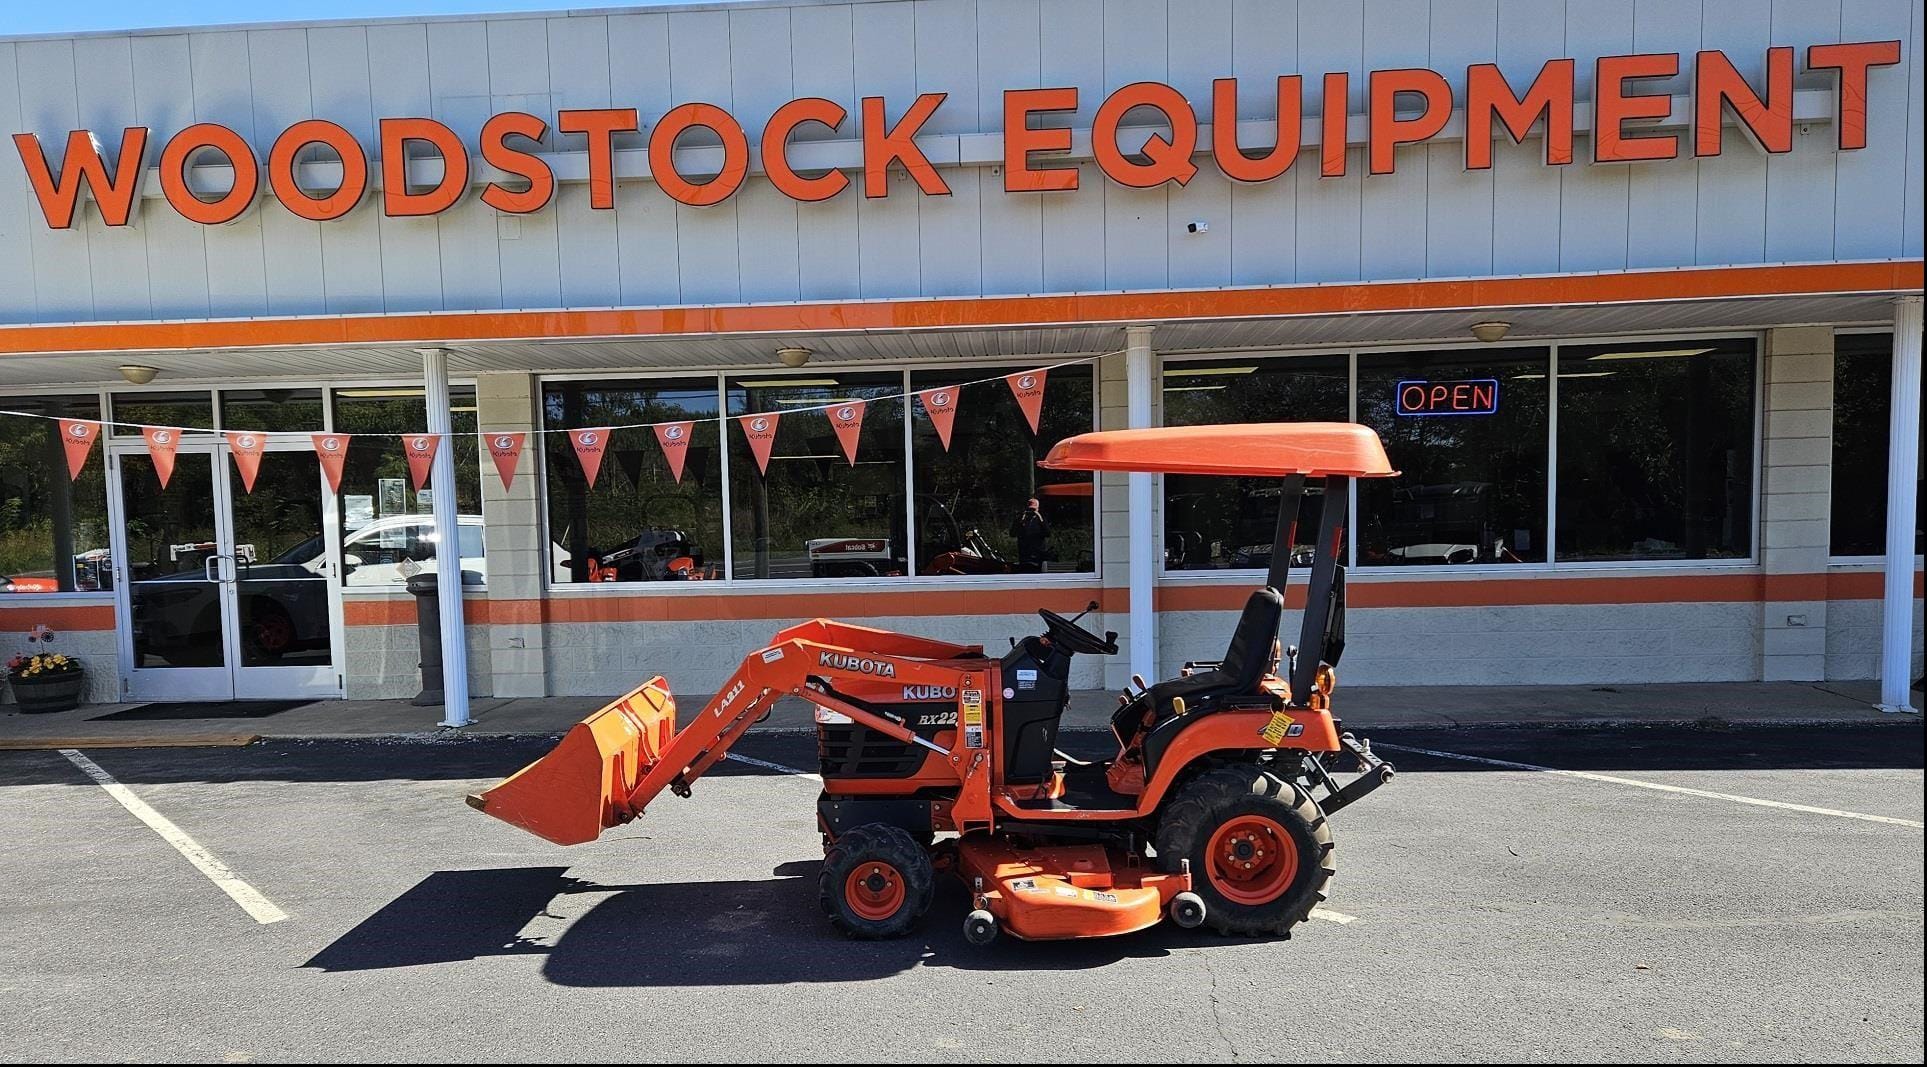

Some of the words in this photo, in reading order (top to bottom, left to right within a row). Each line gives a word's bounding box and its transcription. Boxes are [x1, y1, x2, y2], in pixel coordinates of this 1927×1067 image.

[12, 92, 953, 230] WOODSTOCK
[1003, 39, 1902, 193] EQUIPMENT
[1402, 385, 1493, 411] OPEN
[818, 650, 897, 678] KUBOTA
[713, 679, 746, 718] LA211
[902, 684, 958, 700] KUBO
[917, 711, 959, 727] BX22
